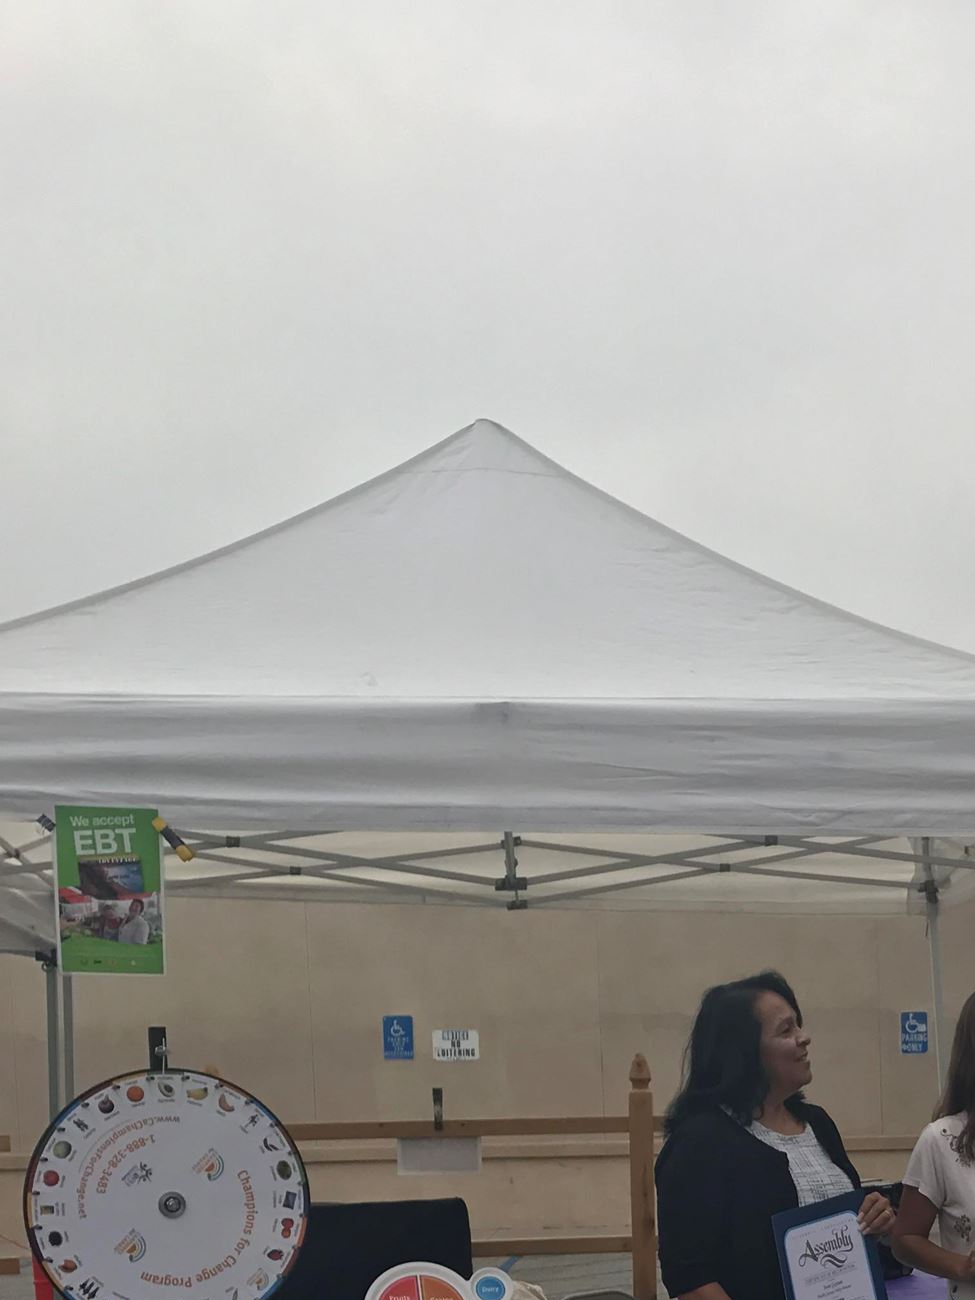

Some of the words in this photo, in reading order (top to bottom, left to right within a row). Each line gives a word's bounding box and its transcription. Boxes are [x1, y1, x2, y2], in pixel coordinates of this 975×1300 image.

[69, 815, 89, 827] We
[92, 814, 135, 828] accept
[73, 828, 136, 856] EBT
[437, 1048, 476, 1057] LOITERING
[237, 1169, 258, 1236] Champions
[235, 1237, 251, 1256] for
[799, 1225, 854, 1267] Assembly
[196, 1254, 237, 1283] Change
[140, 1271, 193, 1288] Program
[481, 1286, 500, 1294] Dairy
